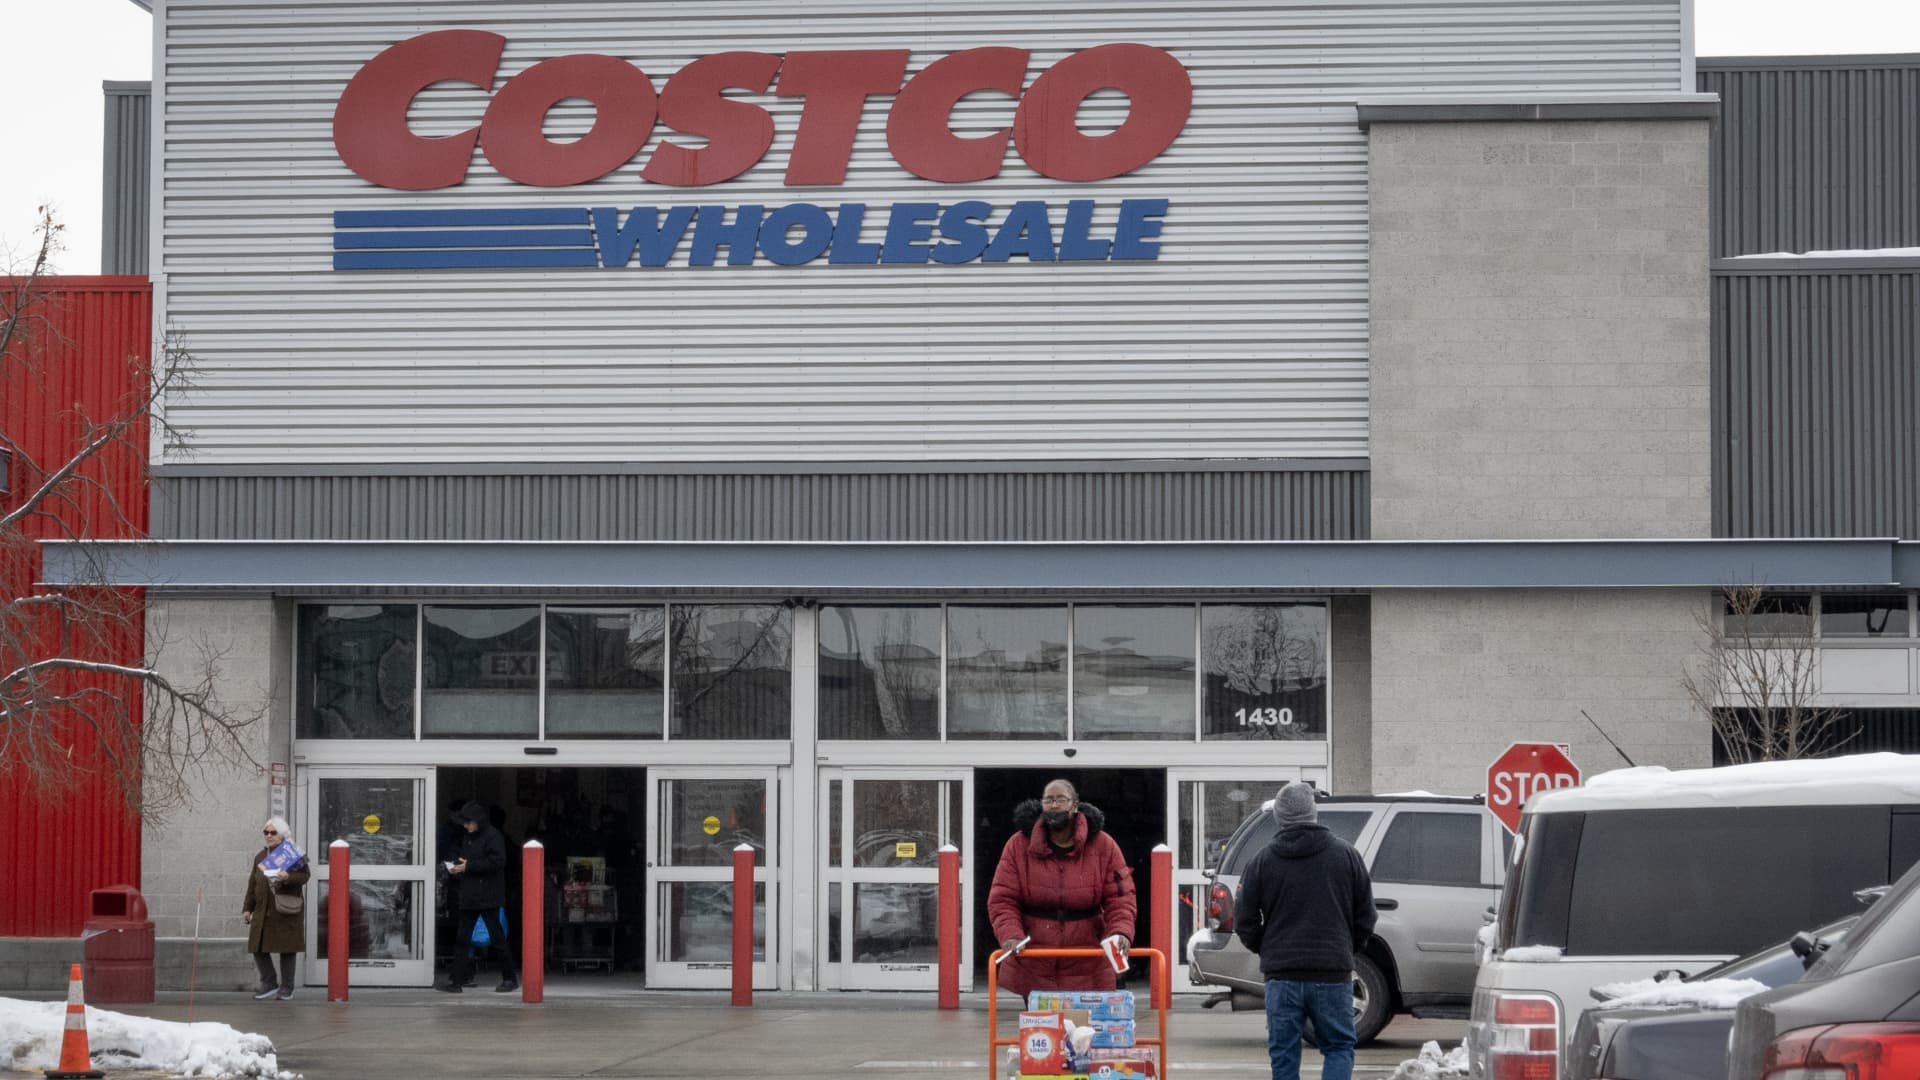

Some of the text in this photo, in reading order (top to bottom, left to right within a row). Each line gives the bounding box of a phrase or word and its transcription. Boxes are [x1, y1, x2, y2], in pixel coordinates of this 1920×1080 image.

[333, 29, 1192, 190] COSTCO
[591, 199, 1169, 267] WHOLESALE
[1235, 707, 1293, 726] 1430
[1031, 1039, 1047, 1048] 146
